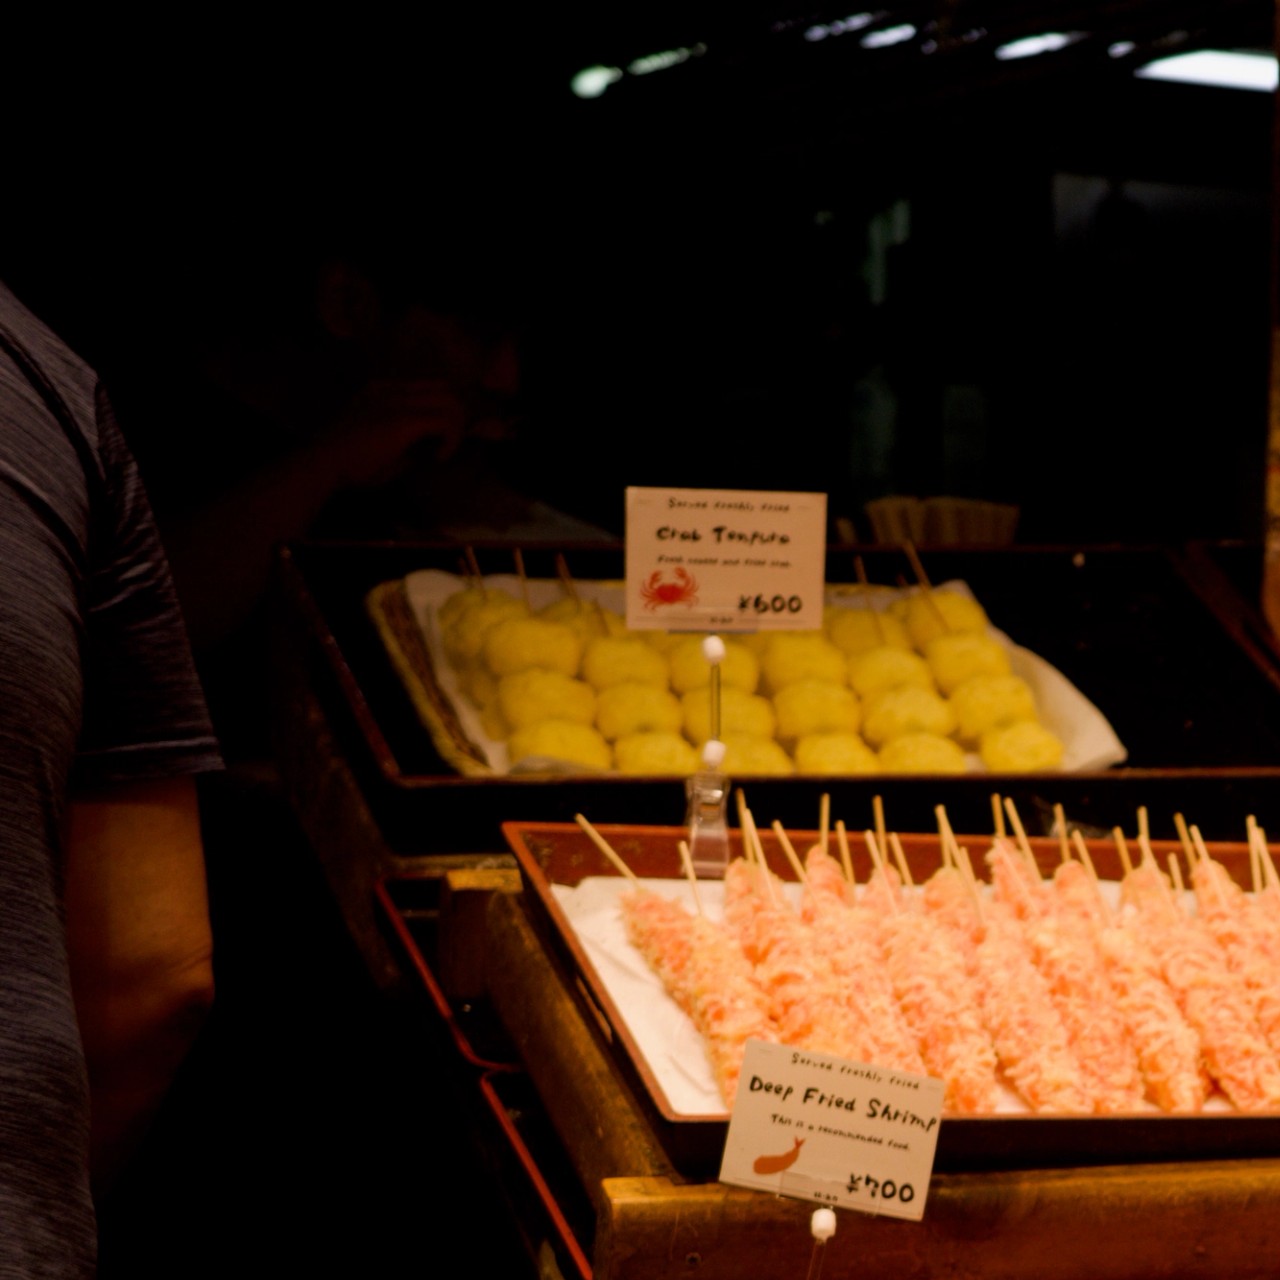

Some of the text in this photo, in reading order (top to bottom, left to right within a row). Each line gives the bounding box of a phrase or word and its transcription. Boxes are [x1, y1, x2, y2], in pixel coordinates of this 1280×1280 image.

[656, 526, 701, 542] Crab
[738, 594, 802, 614] ¥600
[791, 1052, 920, 1090] Served freshly fried
[749, 1074, 938, 1132] Deep Fried Shrimp
[770, 1113, 792, 1126] This
[795, 1119, 804, 1129] is
[818, 1125, 883, 1146] recommended
[846, 1172, 914, 1203] ¥700
